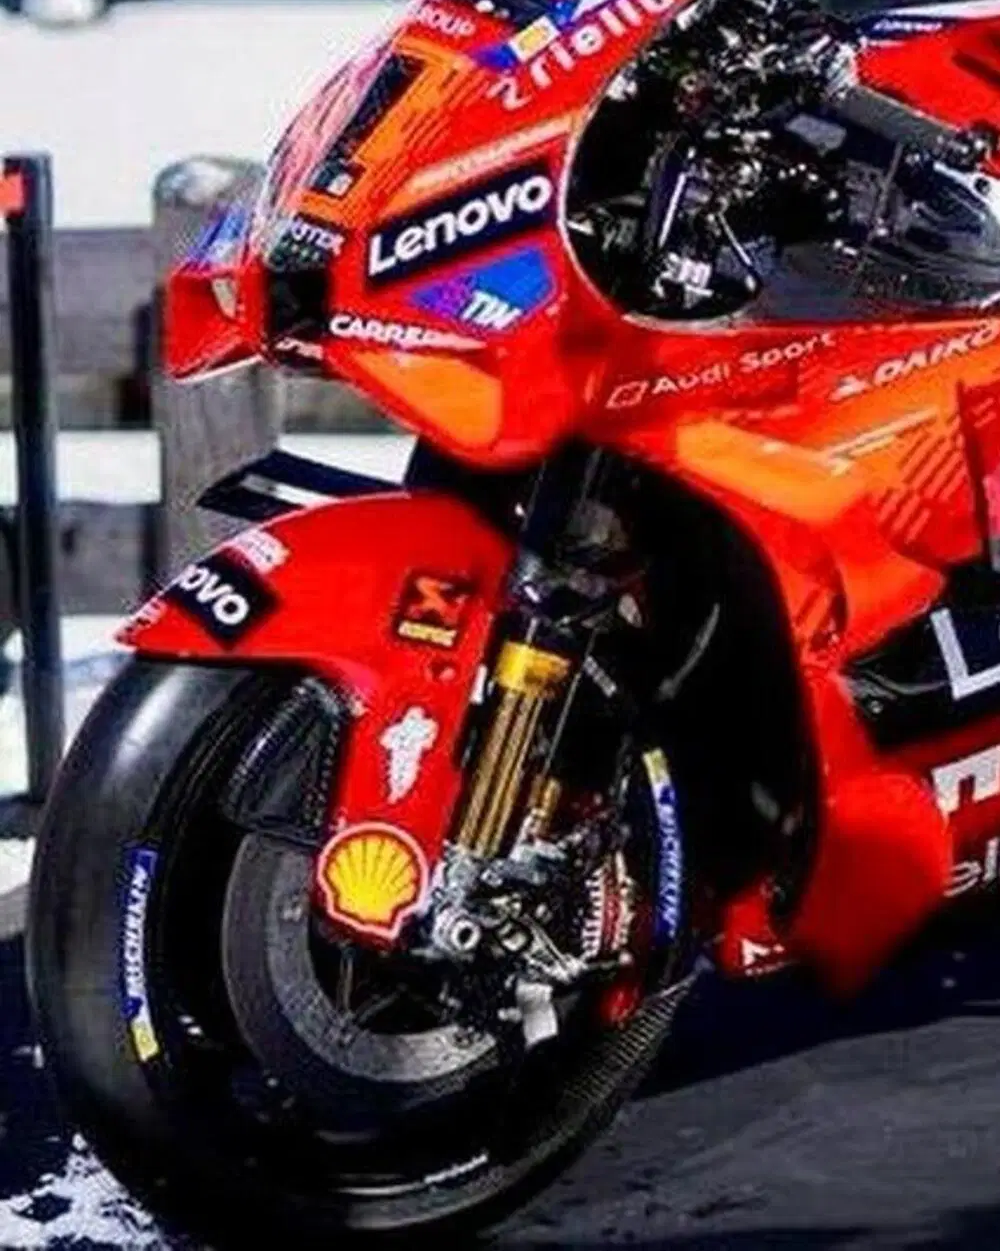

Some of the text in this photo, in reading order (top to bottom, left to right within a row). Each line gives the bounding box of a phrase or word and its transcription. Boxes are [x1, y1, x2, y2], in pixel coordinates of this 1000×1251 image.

[368, 175, 552, 277] Lenovo
[462, 289, 522, 331] TIM
[653, 331, 836, 395] Audi Sport
